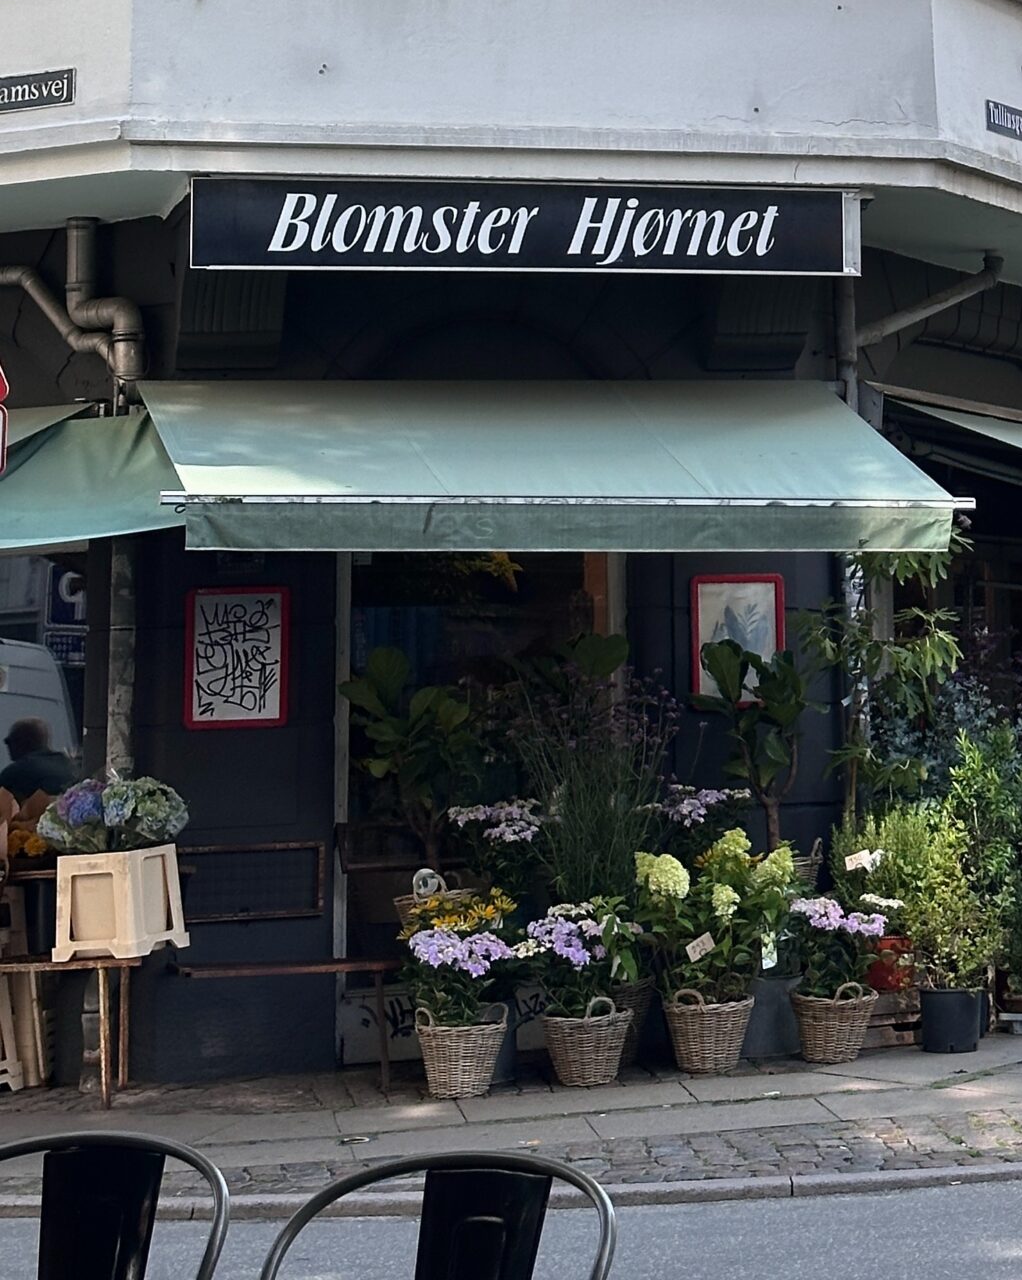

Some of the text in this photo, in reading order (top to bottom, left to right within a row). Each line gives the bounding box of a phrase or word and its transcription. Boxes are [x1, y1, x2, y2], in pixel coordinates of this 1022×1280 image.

[0, 74, 68, 103] amsvej
[267, 193, 779, 265] Blomster Hjørnet
